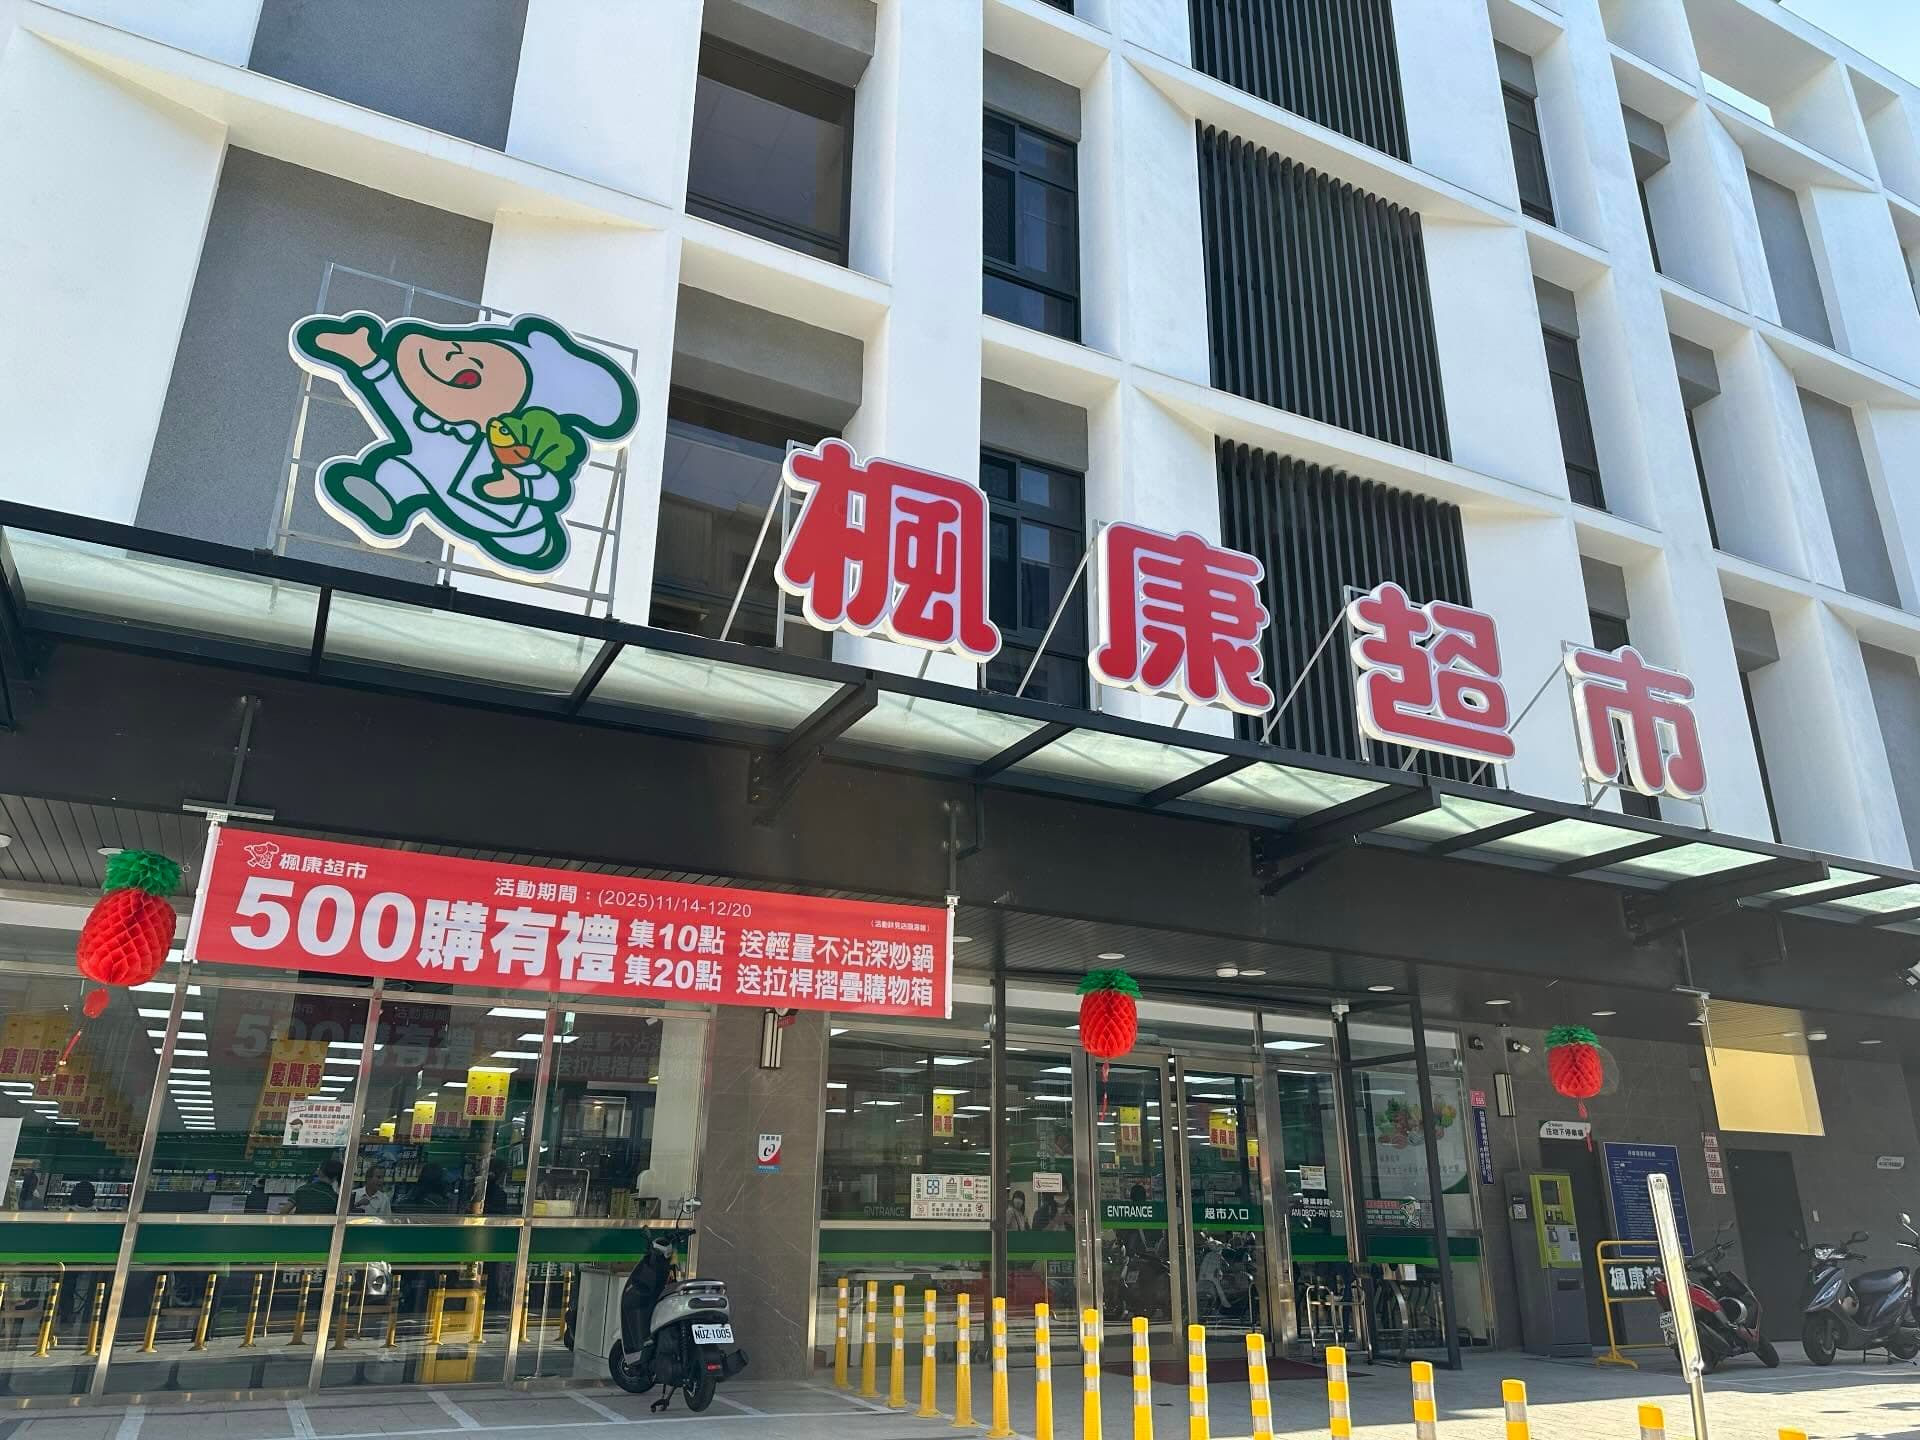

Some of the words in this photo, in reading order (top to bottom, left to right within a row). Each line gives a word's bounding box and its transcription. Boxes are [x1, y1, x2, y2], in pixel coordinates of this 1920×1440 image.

[778, 439, 1705, 795] 楓康超市
[279, 853, 368, 879] 楓康超市
[230, 876, 619, 983] 500購有禮
[627, 918, 726, 955] 集10點
[739, 928, 934, 975] 送輕量不沾深炒鍋
[623, 954, 722, 992] 集20點
[736, 963, 933, 1008] 送拉桿摺疊購物箱
[269, 1062, 322, 1089] 慶開幕
[1107, 1205, 1153, 1218] ENTRANCE
[1204, 1207, 1249, 1220] 超市入口
[695, 1329, 731, 1339] NUZ-1005
